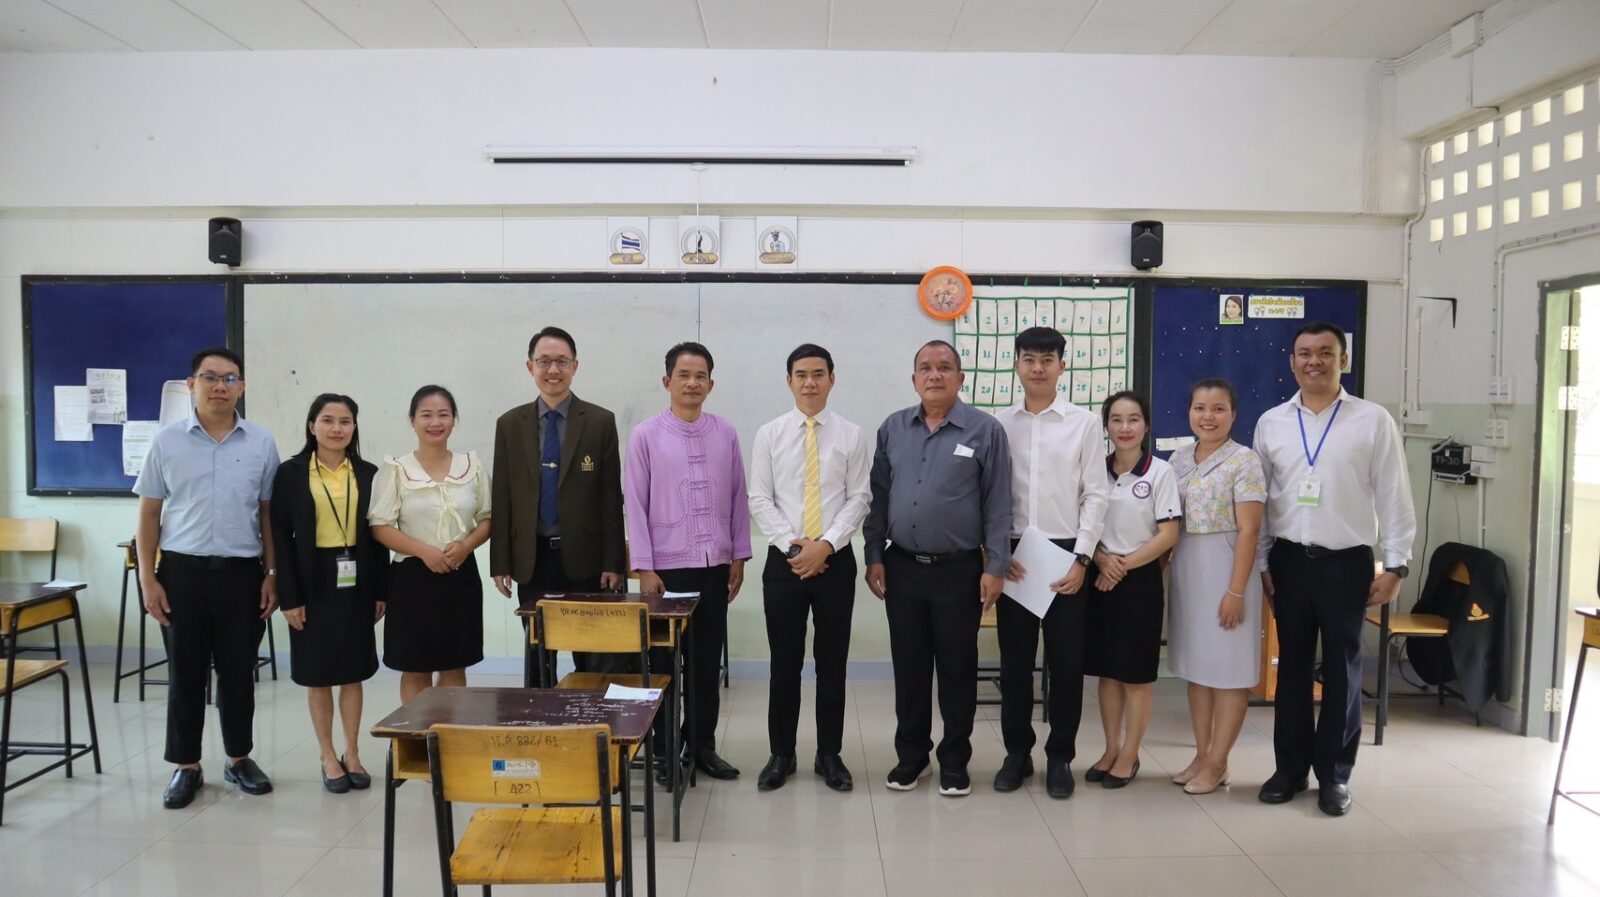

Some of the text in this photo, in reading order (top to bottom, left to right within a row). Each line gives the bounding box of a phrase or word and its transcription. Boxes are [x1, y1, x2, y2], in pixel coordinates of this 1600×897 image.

[964, 315, 969, 324] 1
[985, 316, 992, 325] 2
[1002, 316, 1009, 325] 3
[1022, 316, 1028, 325] 4
[1041, 316, 1048, 325] 5
[1079, 316, 1085, 324] 7
[983, 350, 991, 358] 11
[1098, 348, 1107, 357] 17
[981, 386, 991, 394] 20
[999, 385, 1008, 393] 21
